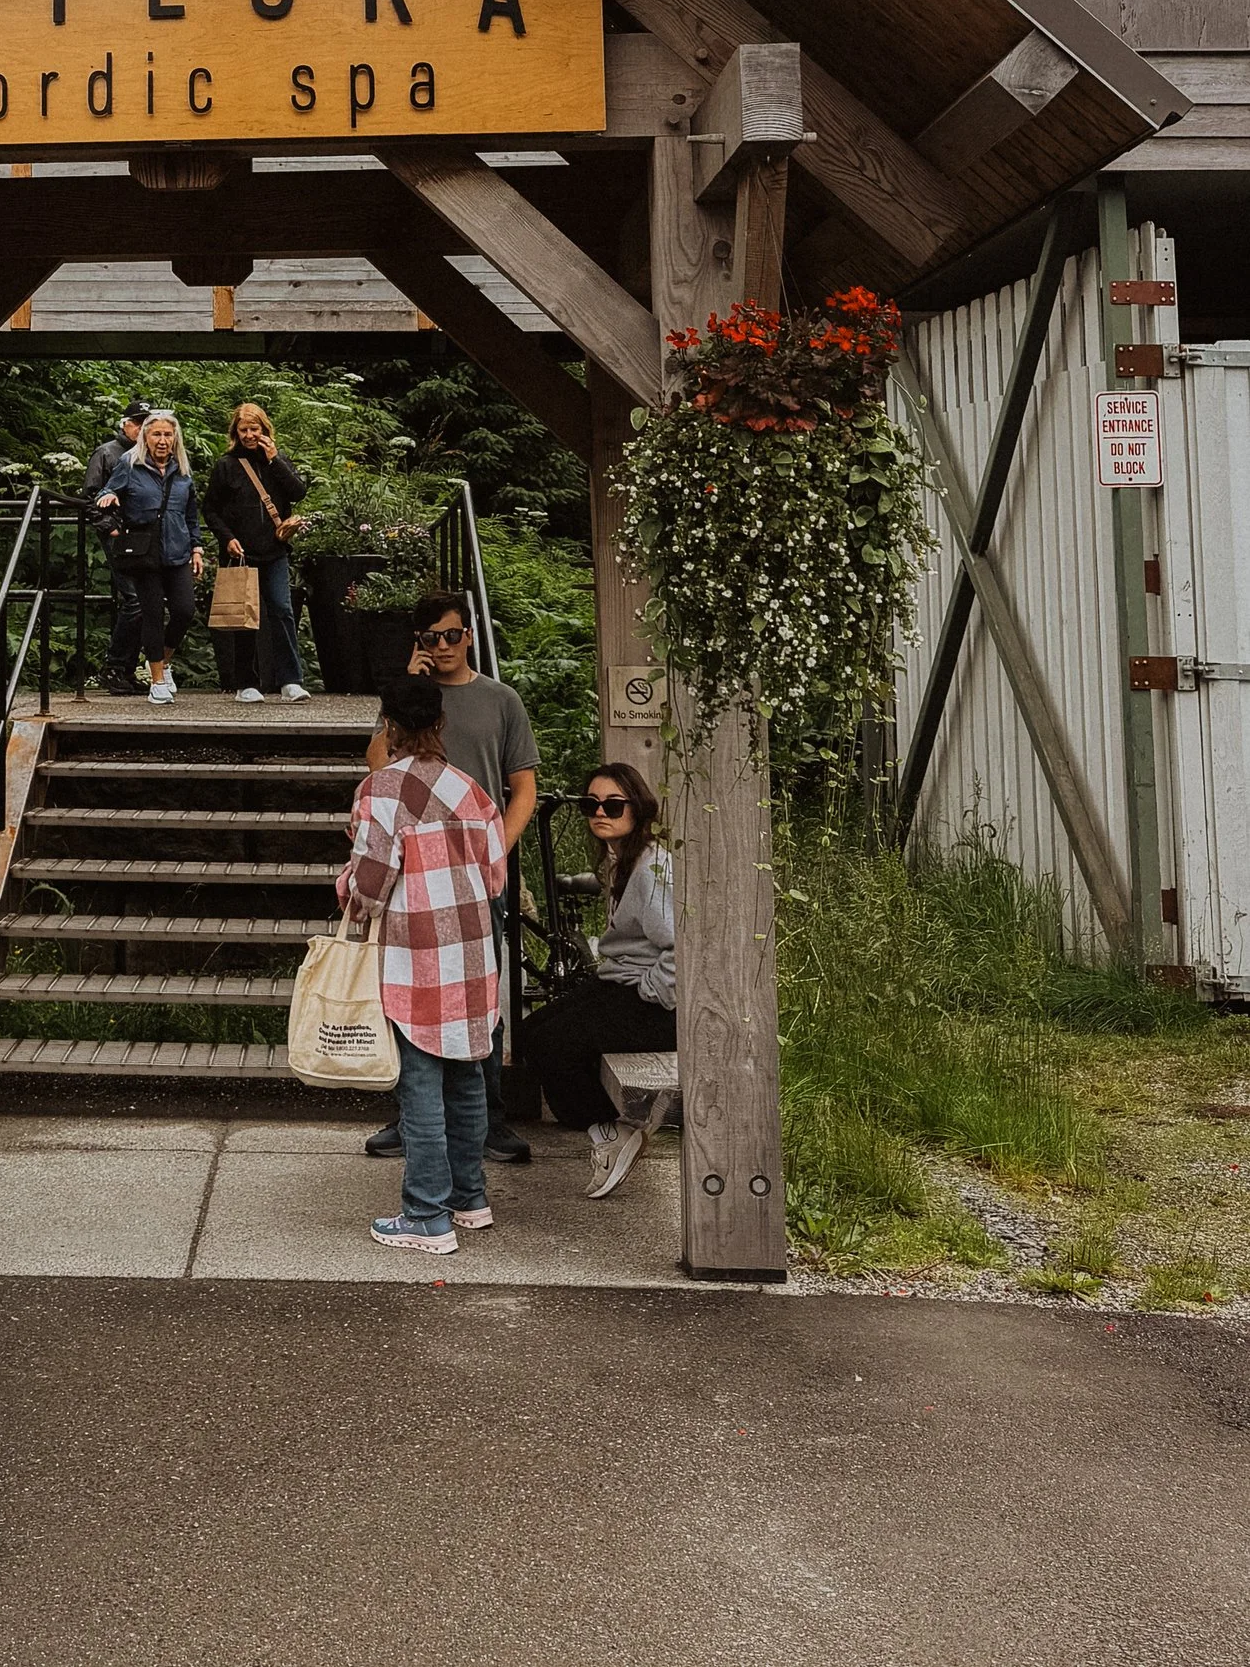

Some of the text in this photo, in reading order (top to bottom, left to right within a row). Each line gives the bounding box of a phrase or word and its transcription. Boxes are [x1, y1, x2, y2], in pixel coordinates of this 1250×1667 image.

[290, 61, 436, 129] spa
[1107, 401, 1148, 414] SERVICE
[1103, 419, 1154, 432] ENTRANCE
[1110, 443, 1146, 456] DO NOT
[1114, 461, 1146, 474] BLOCK
[613, 710, 663, 720] No Smokin
